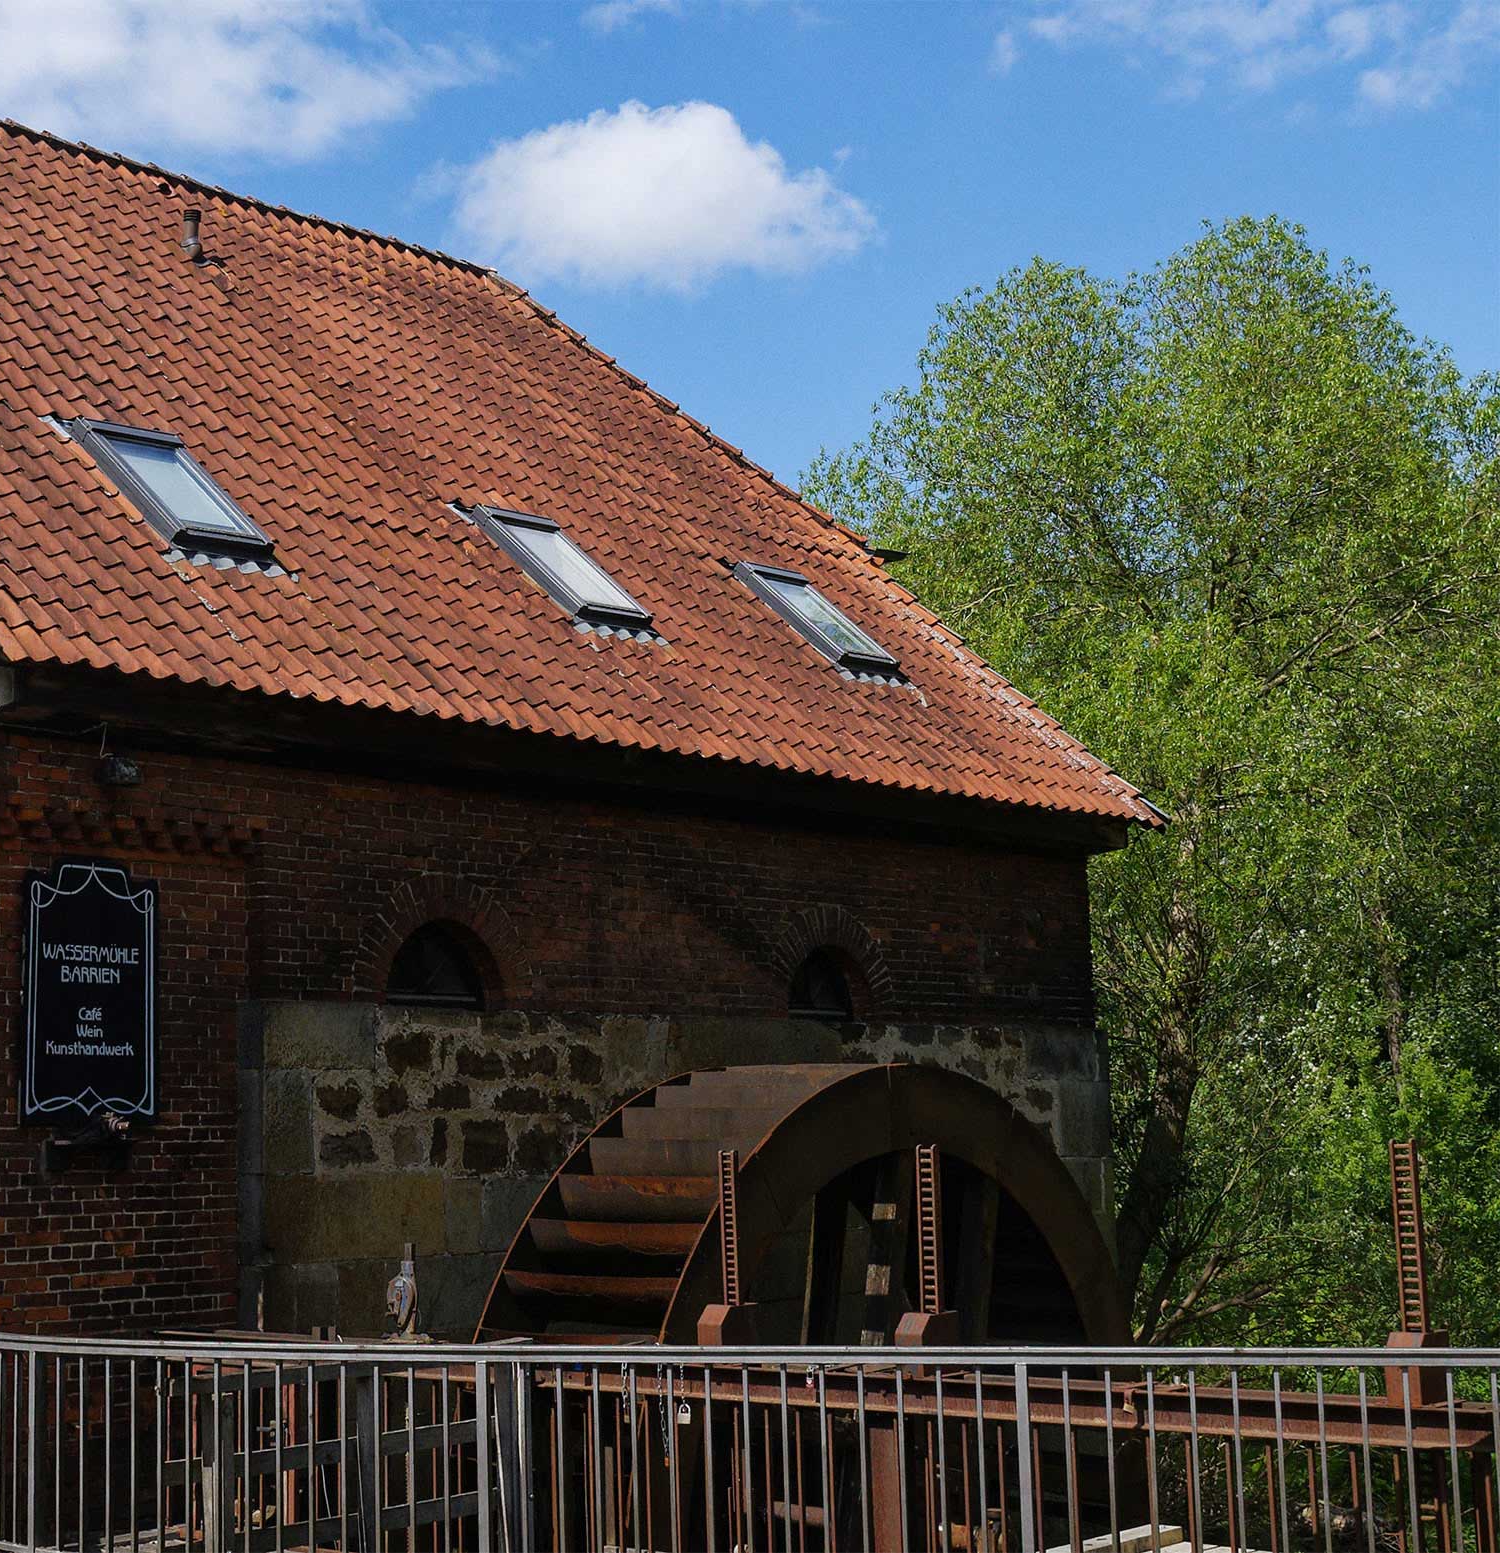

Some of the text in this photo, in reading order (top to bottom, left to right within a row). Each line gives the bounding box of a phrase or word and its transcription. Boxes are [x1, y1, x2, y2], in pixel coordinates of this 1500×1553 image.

[42, 942, 140, 965] WASSERMÜHLE
[60, 965, 121, 984] BARRIEN
[78, 1006, 102, 1021] Café
[76, 1023, 103, 1038] Wein
[45, 1040, 135, 1056] Kunsthandwerk
